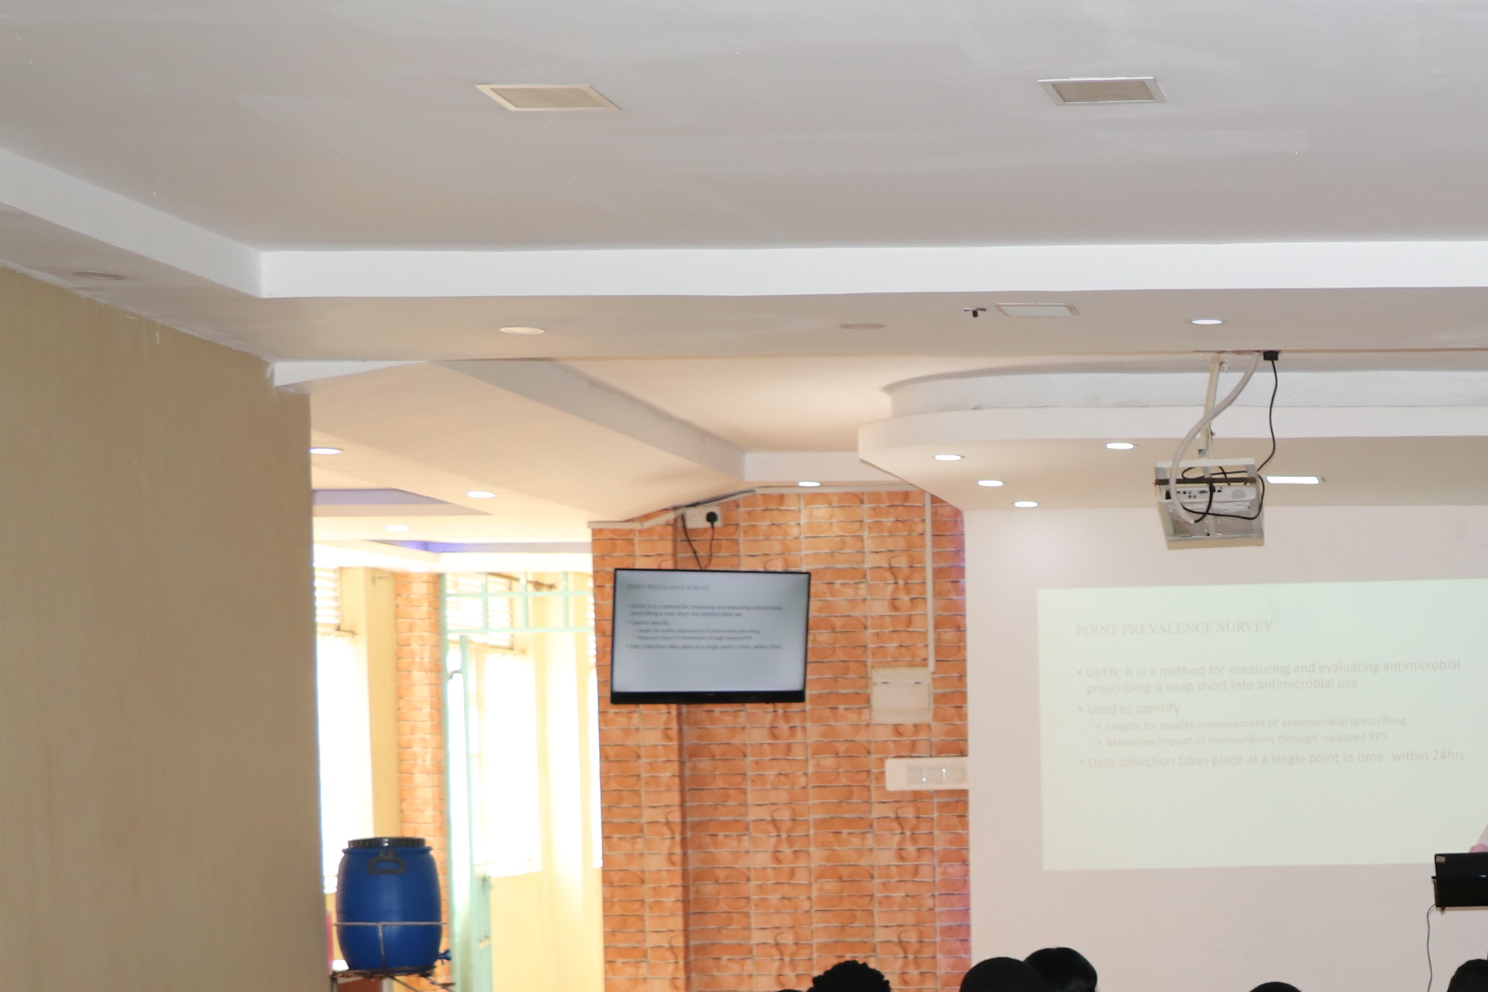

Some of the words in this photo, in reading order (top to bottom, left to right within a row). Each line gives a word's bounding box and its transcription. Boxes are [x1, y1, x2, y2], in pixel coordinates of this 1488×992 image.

[1077, 623, 1117, 636] POINT
[1122, 622, 1213, 635] PREVALENCE
[1217, 620, 1273, 632] SURVEY
[1125, 667, 1133, 677] It
[1137, 667, 1145, 676] is
[1150, 668, 1155, 676] a
[1160, 665, 1205, 676] method
[1209, 664, 1224, 675] for
[1229, 663, 1290, 676] measuring
[1294, 663, 1315, 673] and
[1319, 661, 1379, 674] evaluating
[1383, 660, 1460, 671] antimicrobial
[1167, 683, 1193, 693] snap
[1198, 680, 1227, 691] short
[1231, 680, 1253, 690] into
[1257, 678, 1334, 690] antimicrobial
[1338, 680, 1358, 688] use
[1088, 704, 1116, 715] Used
[1120, 705, 1132, 714] to
[1136, 702, 1180, 715] identify
[1088, 757, 1115, 768] Data
[1119, 756, 1175, 767] collection
[1179, 755, 1209, 766] takes
[1213, 754, 1243, 767] place
[1247, 754, 1257, 764] at
[1262, 755, 1267, 763] a
[1272, 752, 1305, 766] single
[1309, 752, 1339, 765] point
[1343, 752, 1354, 762] in
[1392, 750, 1428, 762] within
[1433, 749, 1465, 761] 24hrs
